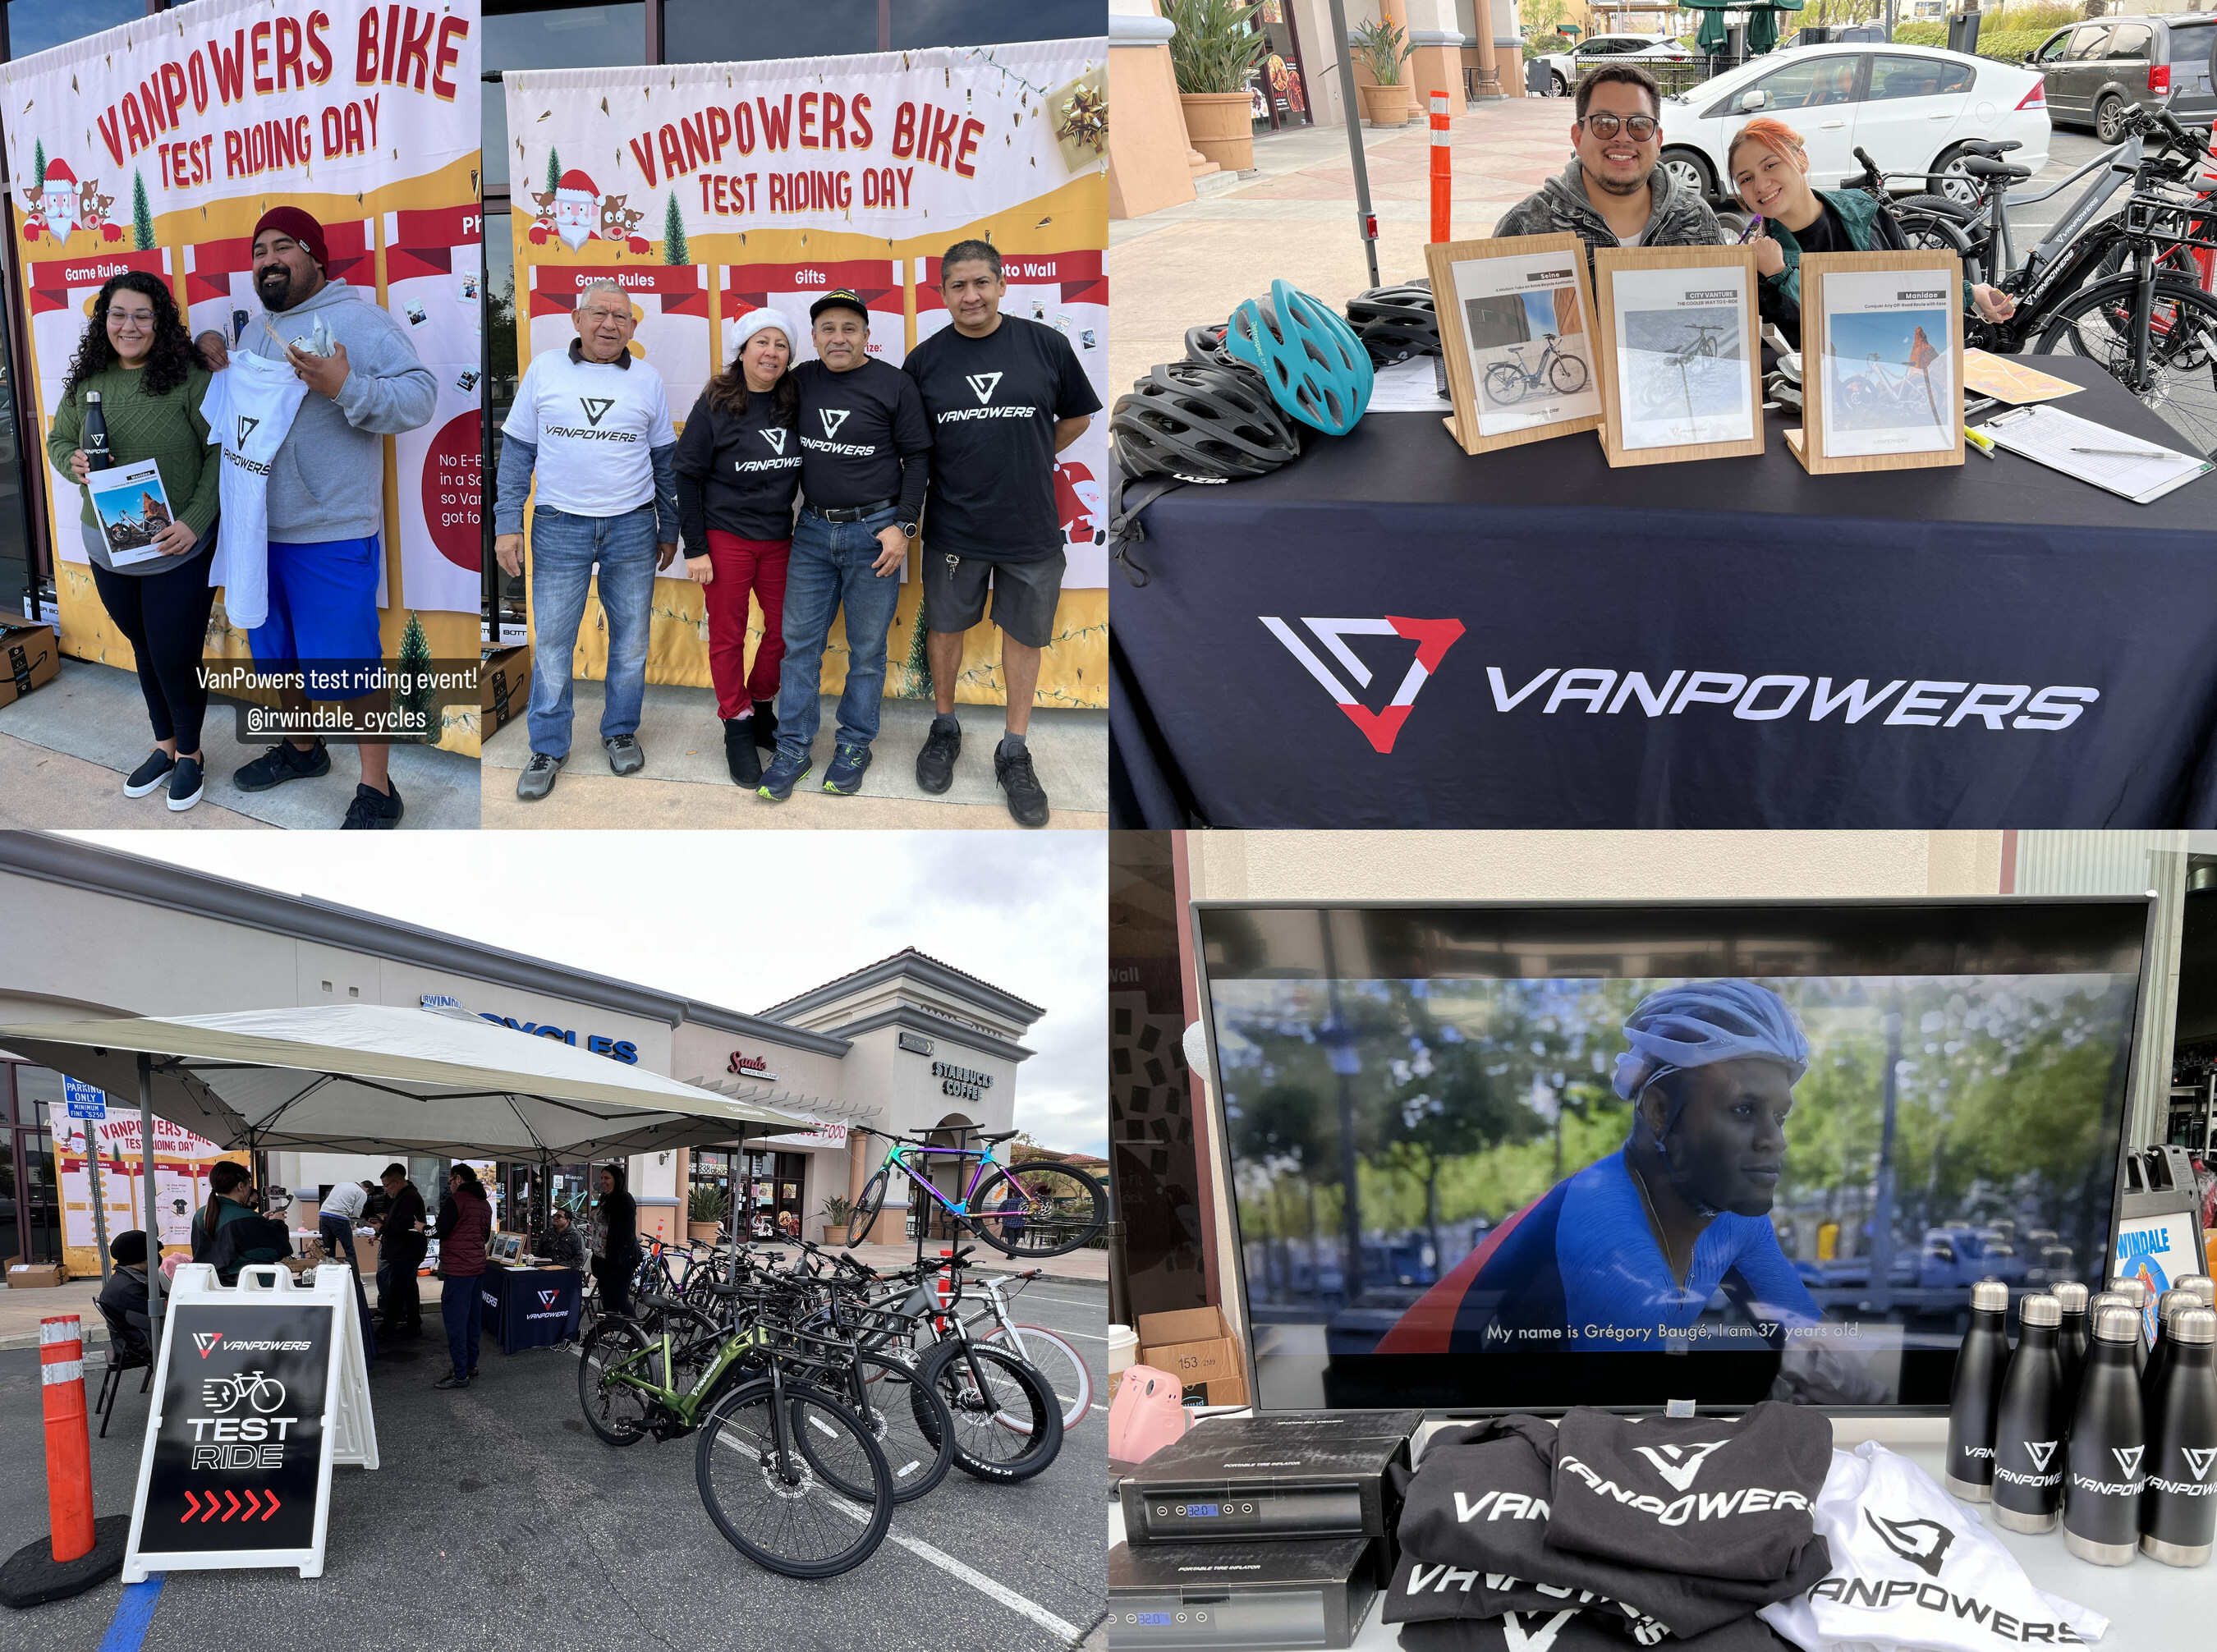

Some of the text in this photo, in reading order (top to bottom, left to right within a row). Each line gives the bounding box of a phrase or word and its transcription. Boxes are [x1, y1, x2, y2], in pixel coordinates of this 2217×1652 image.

[97, 4, 470, 168] VANPOWERS BIKE
[158, 92, 380, 190] TEST RIDING DAY
[629, 91, 985, 189] VANPOWERS BIKE
[700, 166, 914, 216] TEST RIDING DAY
[2062, 196, 2099, 237] VANPOWERS
[65, 262, 129, 282] Game Rules
[795, 270, 826, 284] Gifts
[1024, 262, 1056, 277] Wall
[2032, 249, 2075, 299] VANPOWERS
[618, 273, 654, 287] Rules
[1251, 320, 1264, 357] Retrospec
[937, 406, 1036, 424] VANPOWERS
[545, 424, 637, 443] VANPOWERS
[439, 454, 457, 466] No
[440, 472, 452, 485] in
[455, 475, 464, 486] a
[1173, 473, 1229, 484] LAZER
[441, 494, 457, 504] so
[442, 512, 464, 526] got
[1485, 667, 2100, 731] VANPOWERS
[903, 1037, 915, 1046] DRIVE
[730, 1051, 767, 1072] Sands
[756, 1071, 778, 1079] RESTAURANT
[934, 1062, 994, 1088] STARBUCKS
[67, 1082, 102, 1094] PARKING
[75, 1092, 96, 1102] ONLY
[946, 1079, 984, 1100] COFFEE
[823, 1124, 847, 1139] FOOD
[178, 1141, 195, 1152] DAY
[705, 1156, 717, 1164] OPEN
[2115, 1228, 2170, 1260] WINDALE
[526, 1310, 568, 1319] VANPOWERS
[1487, 1323, 1864, 1342] My name is Grégory Baugé, I am 37 years old,
[223, 1339, 312, 1351] VANPOWERS
[971, 1343, 1023, 1362] JUGGERNAUT
[1178, 1356, 1198, 1370] 153
[695, 1355, 722, 1392] VANPOWERS
[186, 1417, 297, 1442] TEST
[191, 1444, 284, 1471] RIDE
[962, 1452, 1013, 1476] KENDA
[1188, 1505, 1208, 1516] 32.0
[1139, 1613, 1160, 1625] 32.0
